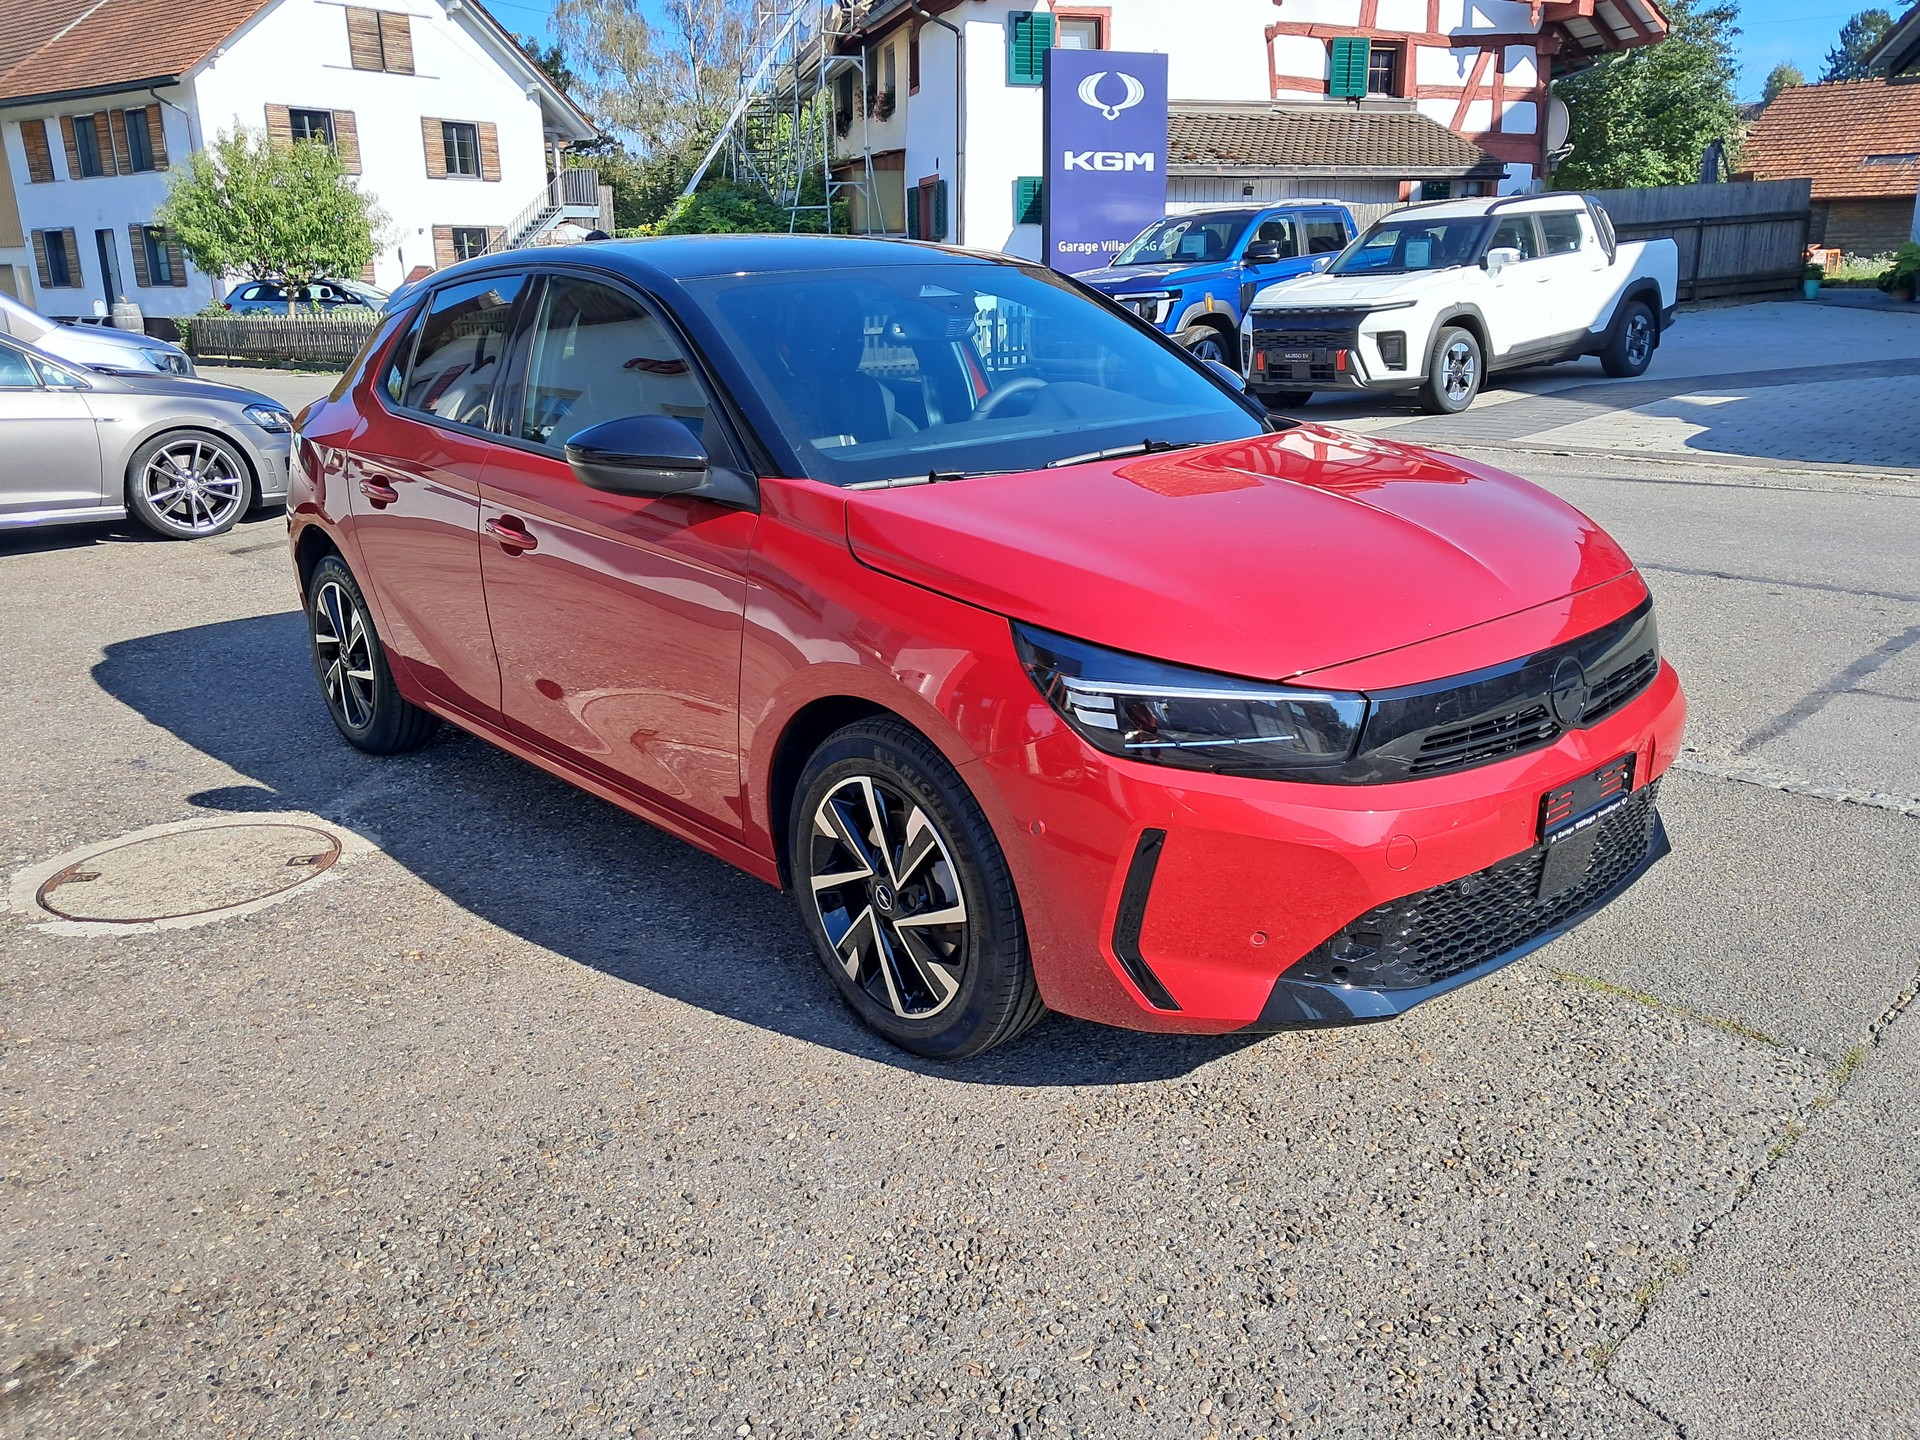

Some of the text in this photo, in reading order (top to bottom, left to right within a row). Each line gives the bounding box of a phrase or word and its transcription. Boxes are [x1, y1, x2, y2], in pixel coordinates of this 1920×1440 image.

[1063, 150, 1155, 172] KGM
[1058, 240, 1099, 255] Garage
[1101, 240, 1131, 252] Villa
[900, 763, 973, 860] MICHELIN
[1575, 815, 1597, 830] Village
